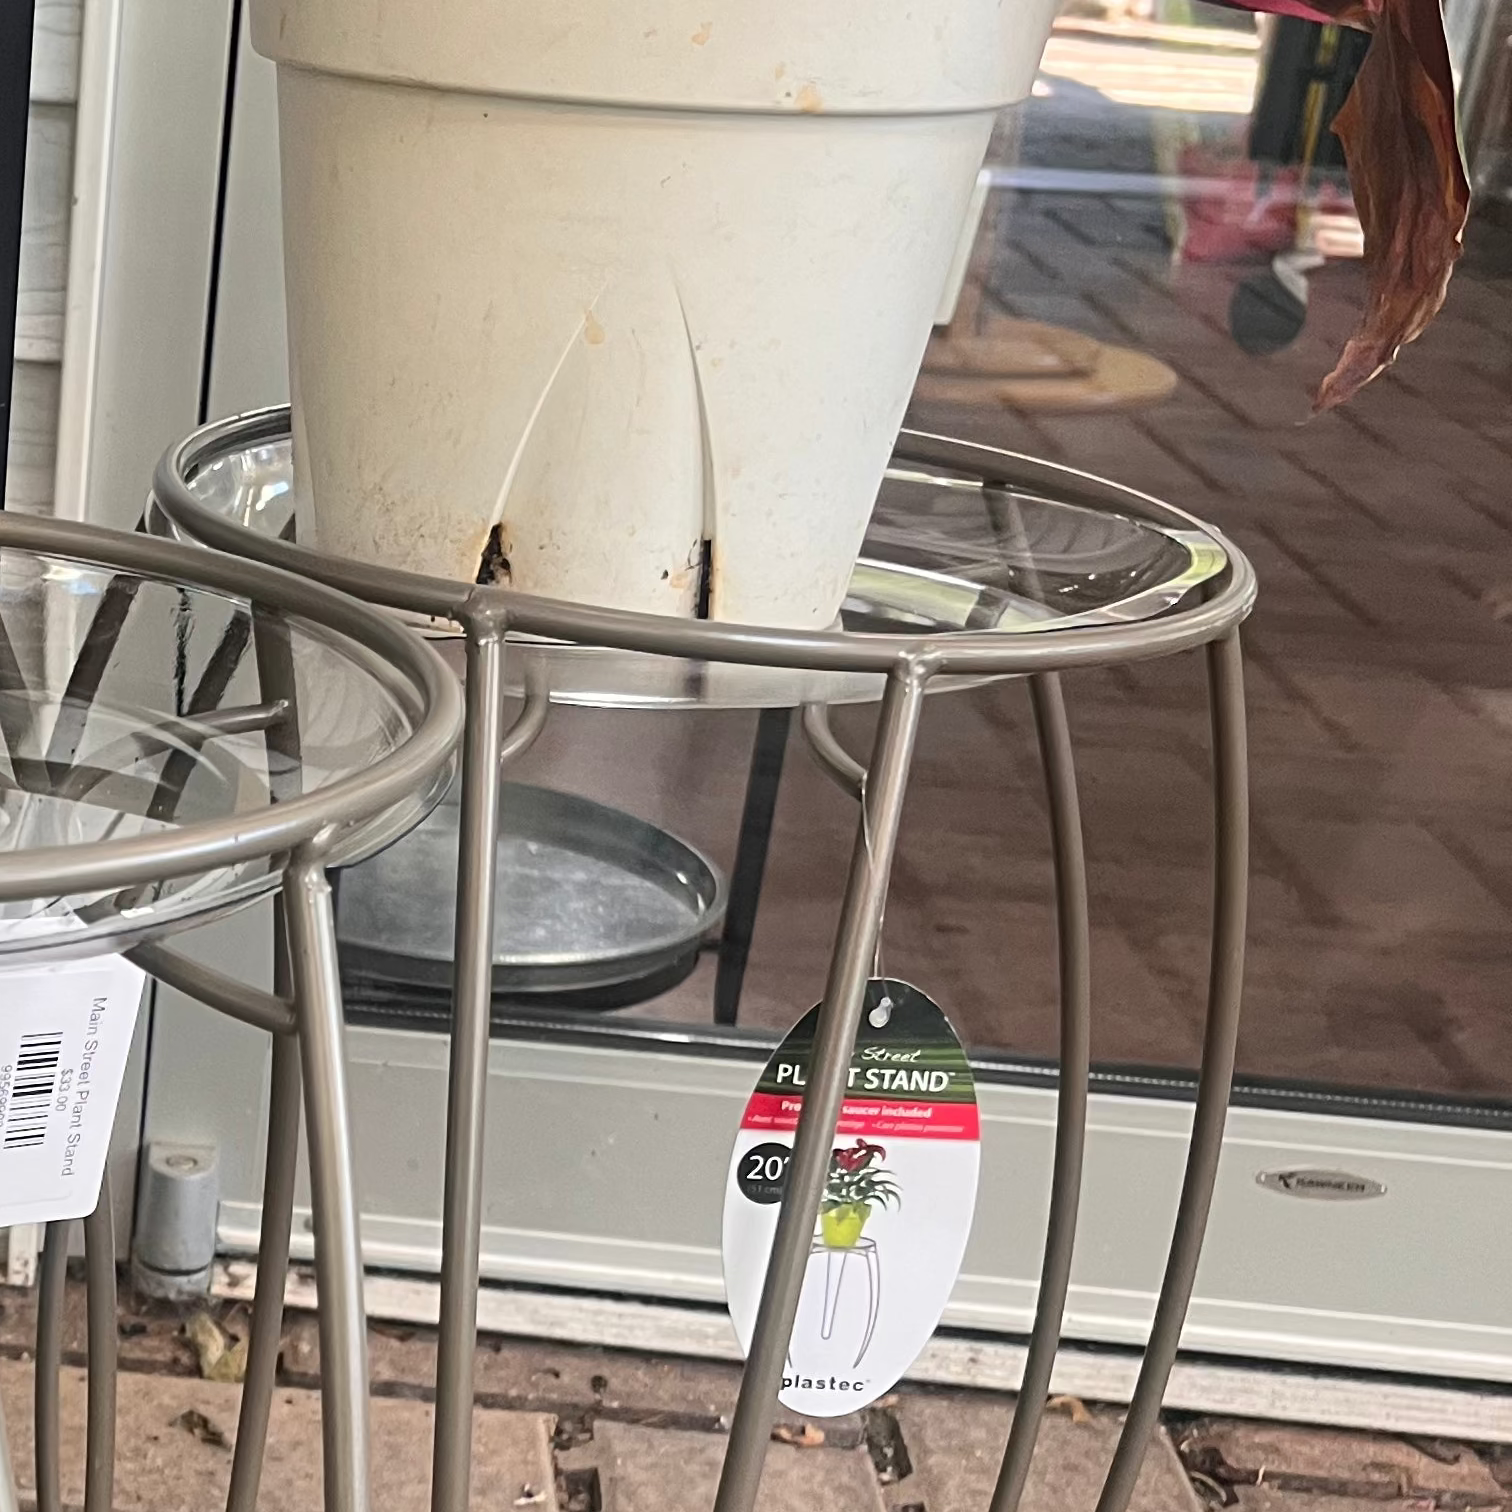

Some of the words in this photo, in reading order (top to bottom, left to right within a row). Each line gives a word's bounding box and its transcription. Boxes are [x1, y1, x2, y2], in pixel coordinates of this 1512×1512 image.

[88, 996, 107, 1036] Main
[77, 1039, 99, 1086] Street
[861, 1046, 922, 1063] Street
[55, 1068, 74, 1112] $33.00
[776, 1063, 861, 1088] PLT
[863, 1068, 950, 1092] STAND
[68, 1090, 90, 1130] Plant
[60, 1132, 81, 1177] Stand
[781, 1374, 866, 1392] plastec
